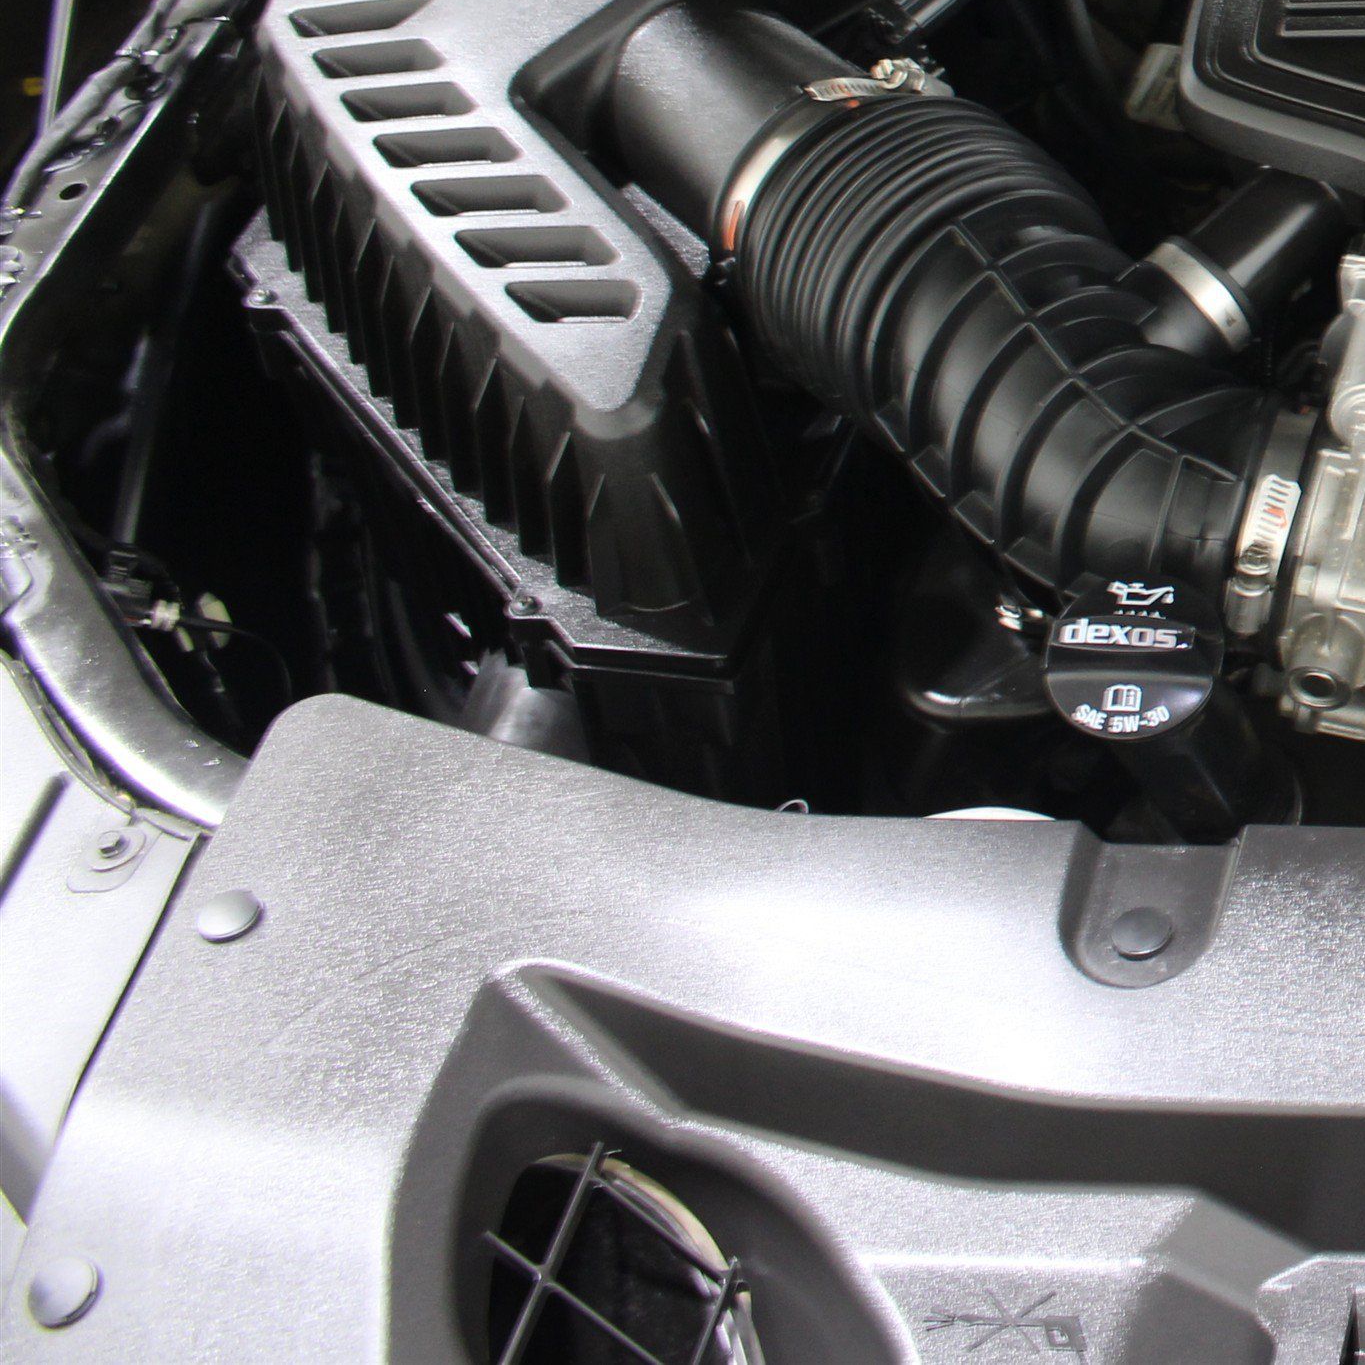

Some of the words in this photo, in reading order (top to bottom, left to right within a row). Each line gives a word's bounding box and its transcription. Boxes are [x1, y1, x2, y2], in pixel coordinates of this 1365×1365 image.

[1059, 618, 1178, 649] dexos
[1071, 704, 1108, 730] SAE
[1108, 705, 1170, 733] 5W-30
